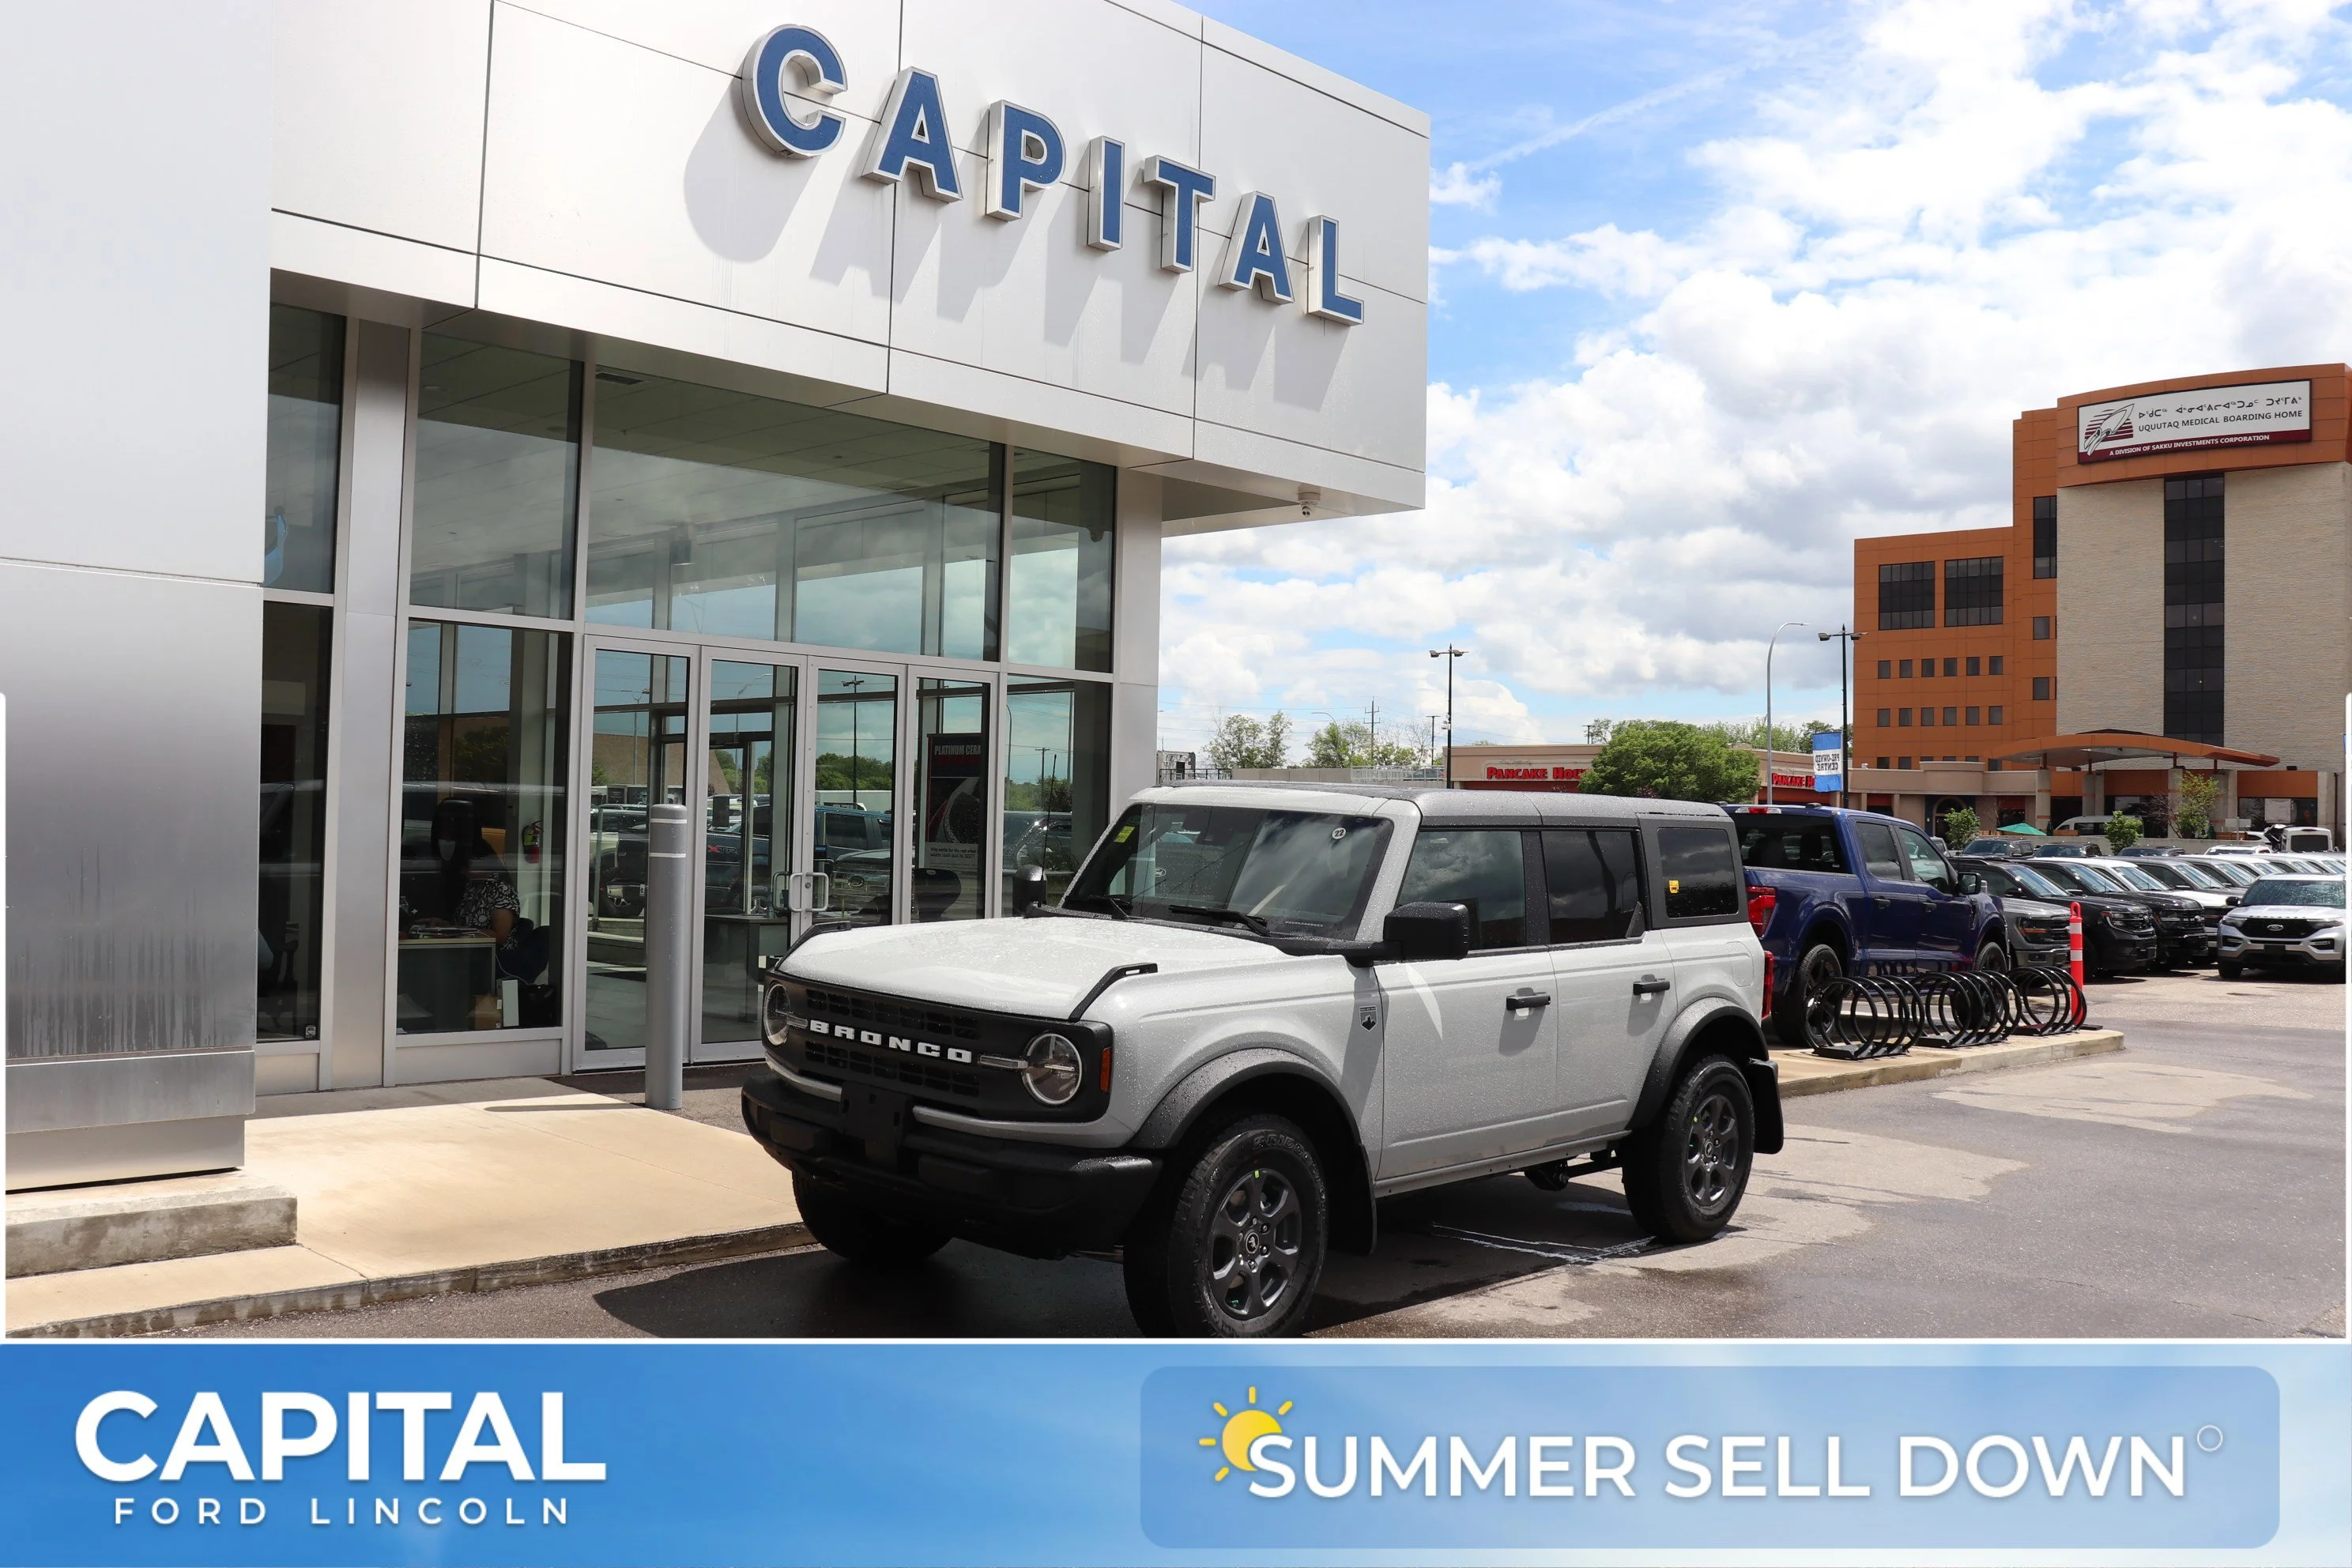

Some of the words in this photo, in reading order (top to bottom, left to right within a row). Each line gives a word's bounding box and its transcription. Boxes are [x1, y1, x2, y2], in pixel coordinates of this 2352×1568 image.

[741, 24, 1365, 326] CAPITAL
[2139, 420, 2179, 432] UQUUTAQ
[2181, 417, 2220, 427] MEDICAL
[2223, 413, 2271, 423] BOARDING
[2274, 410, 2303, 419] HOME
[2115, 447, 2141, 455] DIVISION
[2173, 438, 2219, 448] INVESTMENTS
[2219, 435, 2270, 443] CORPORATION
[934, 745, 964, 756] PLATINUM
[1487, 767, 1548, 779] PANCAKE
[1771, 773, 1805, 786] PANCAKE
[707, 844, 739, 854] XTR
[809, 1020, 972, 1064] BRONCO
